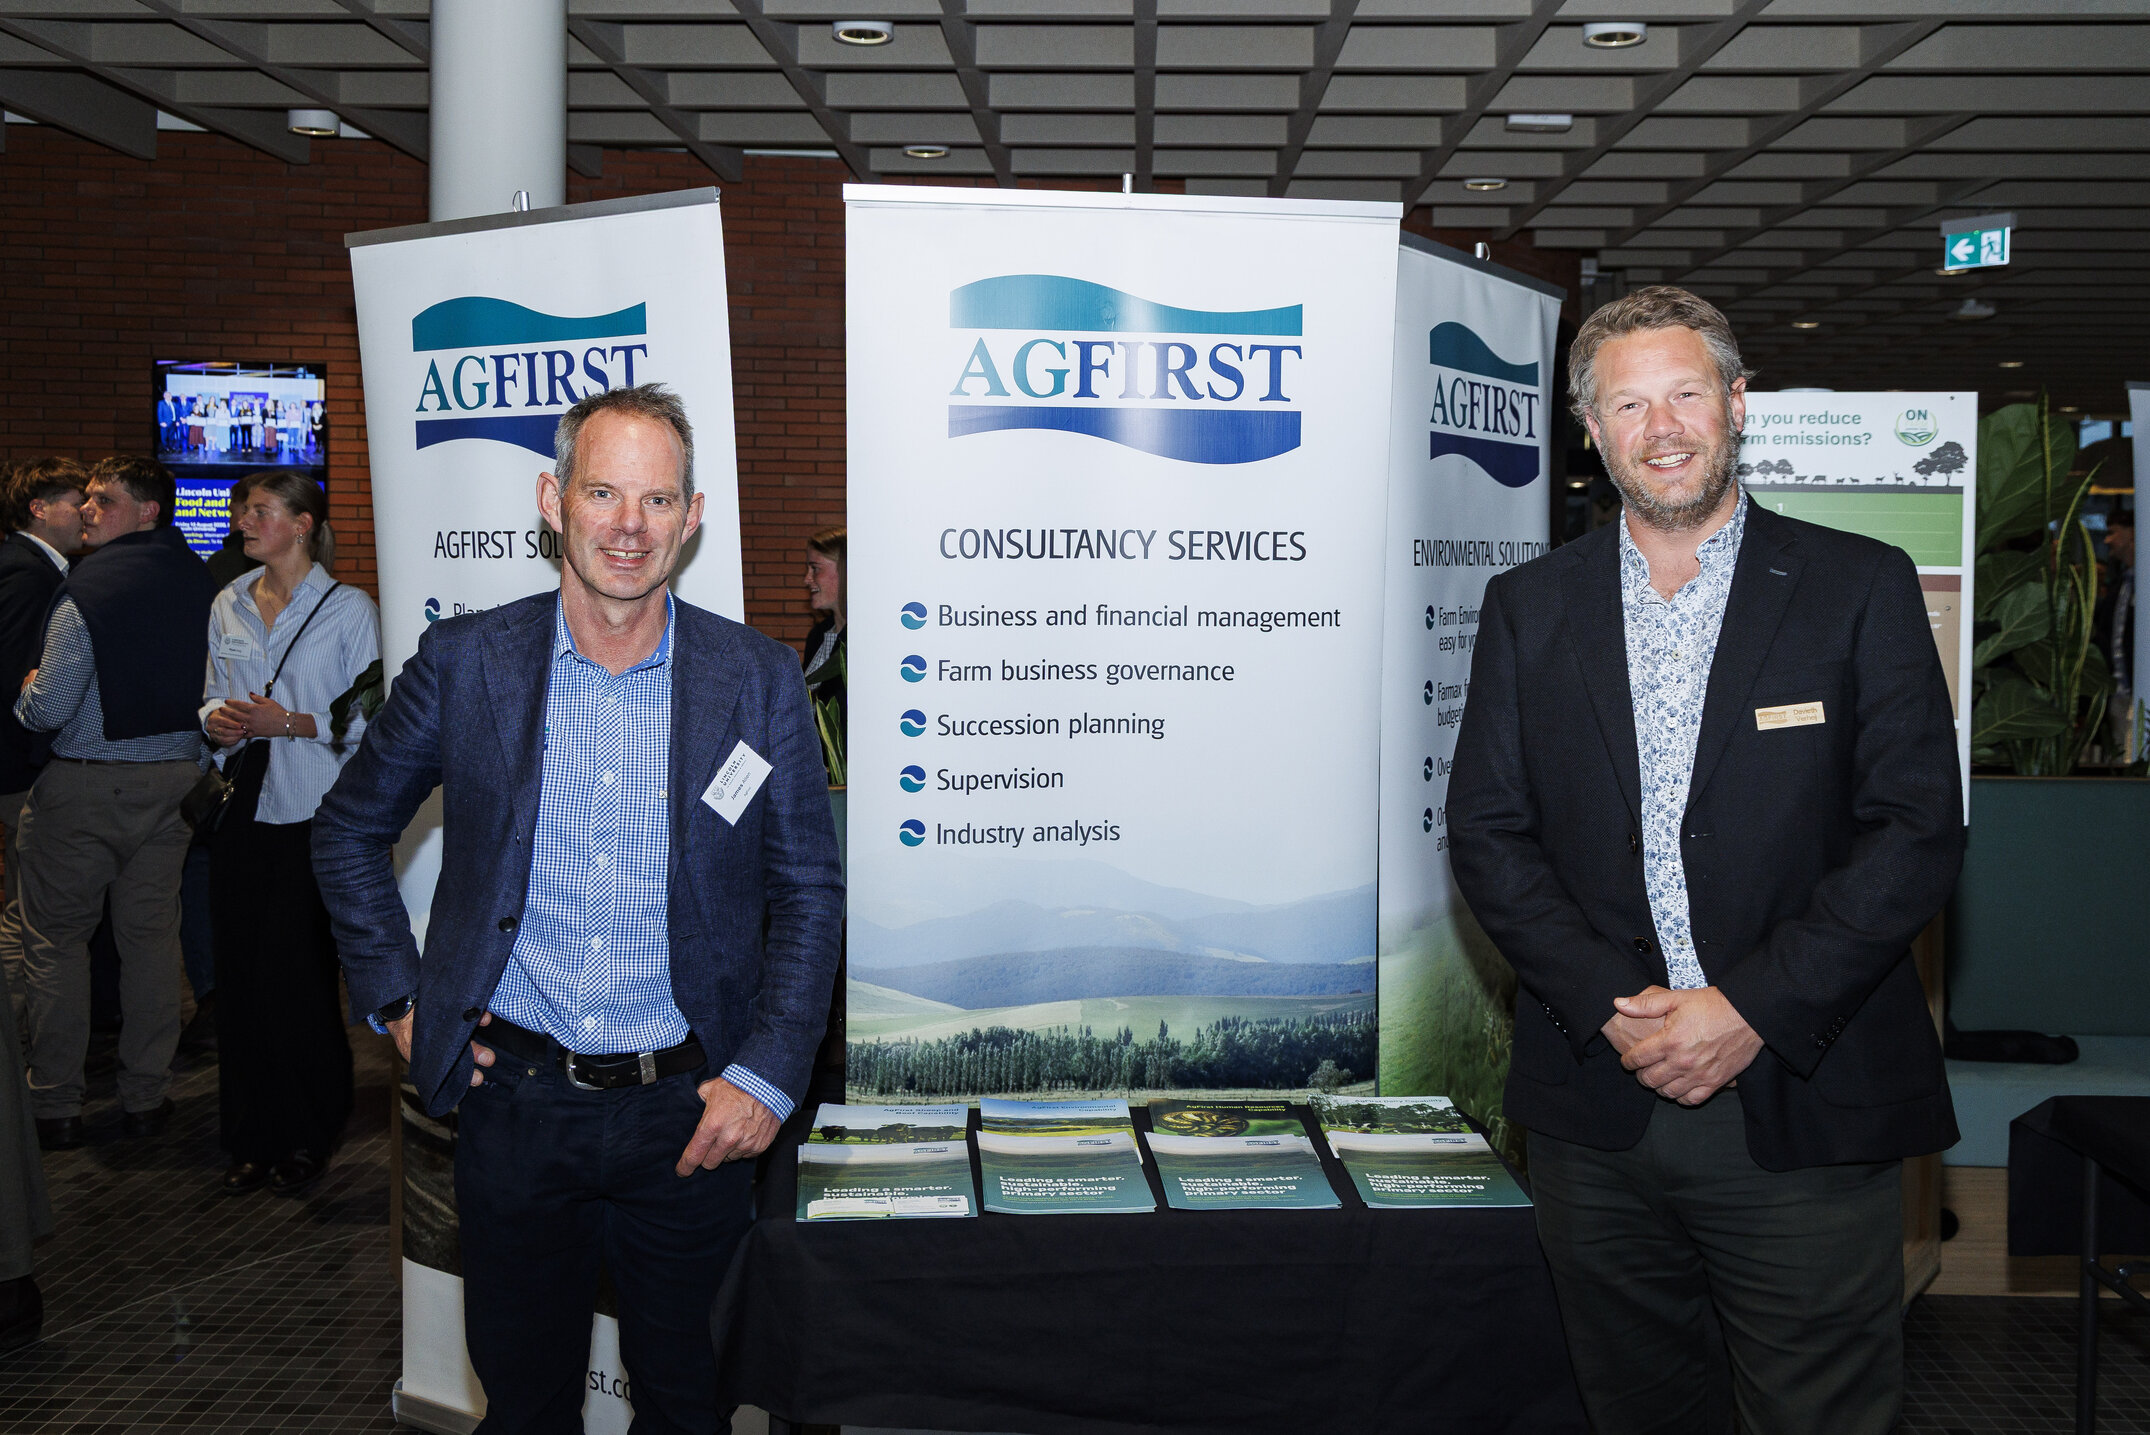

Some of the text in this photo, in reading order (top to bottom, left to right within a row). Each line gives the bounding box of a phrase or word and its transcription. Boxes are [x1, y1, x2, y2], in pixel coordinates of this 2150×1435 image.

[416, 344, 648, 412] AGFIRST
[950, 337, 1302, 403] AGFIRST
[1430, 373, 1540, 438] AGFIRST
[1761, 413, 1794, 428] you
[1799, 410, 1862, 425] reduce
[1906, 409, 1928, 421] ON
[1772, 431, 1872, 446] emissions?
[175, 498, 203, 507] Food
[204, 498, 226, 507] and
[176, 488, 212, 497] Lincoln
[175, 508, 197, 517] and
[434, 530, 563, 559] AGFIRST SOL
[939, 528, 1307, 562] CONSULTANCY SERVICES
[1413, 539, 1496, 567] ENVIRONMENTAL
[939, 604, 1341, 632] Business and financial management
[1438, 605, 1479, 626] Farm Enviro
[1439, 633, 1457, 655] easy
[1458, 630, 1467, 649] for
[938, 658, 1235, 685] Farm business governance
[1438, 682, 1462, 702] Farmax
[937, 712, 1165, 739] Succession planning
[719, 760, 737, 784] LINCOLN
[722, 753, 746, 786] UNIVERSITY
[937, 767, 1064, 795] Supervision
[937, 819, 1121, 848] Industry analysis
[1370, 1181, 1485, 1190] high-performing
